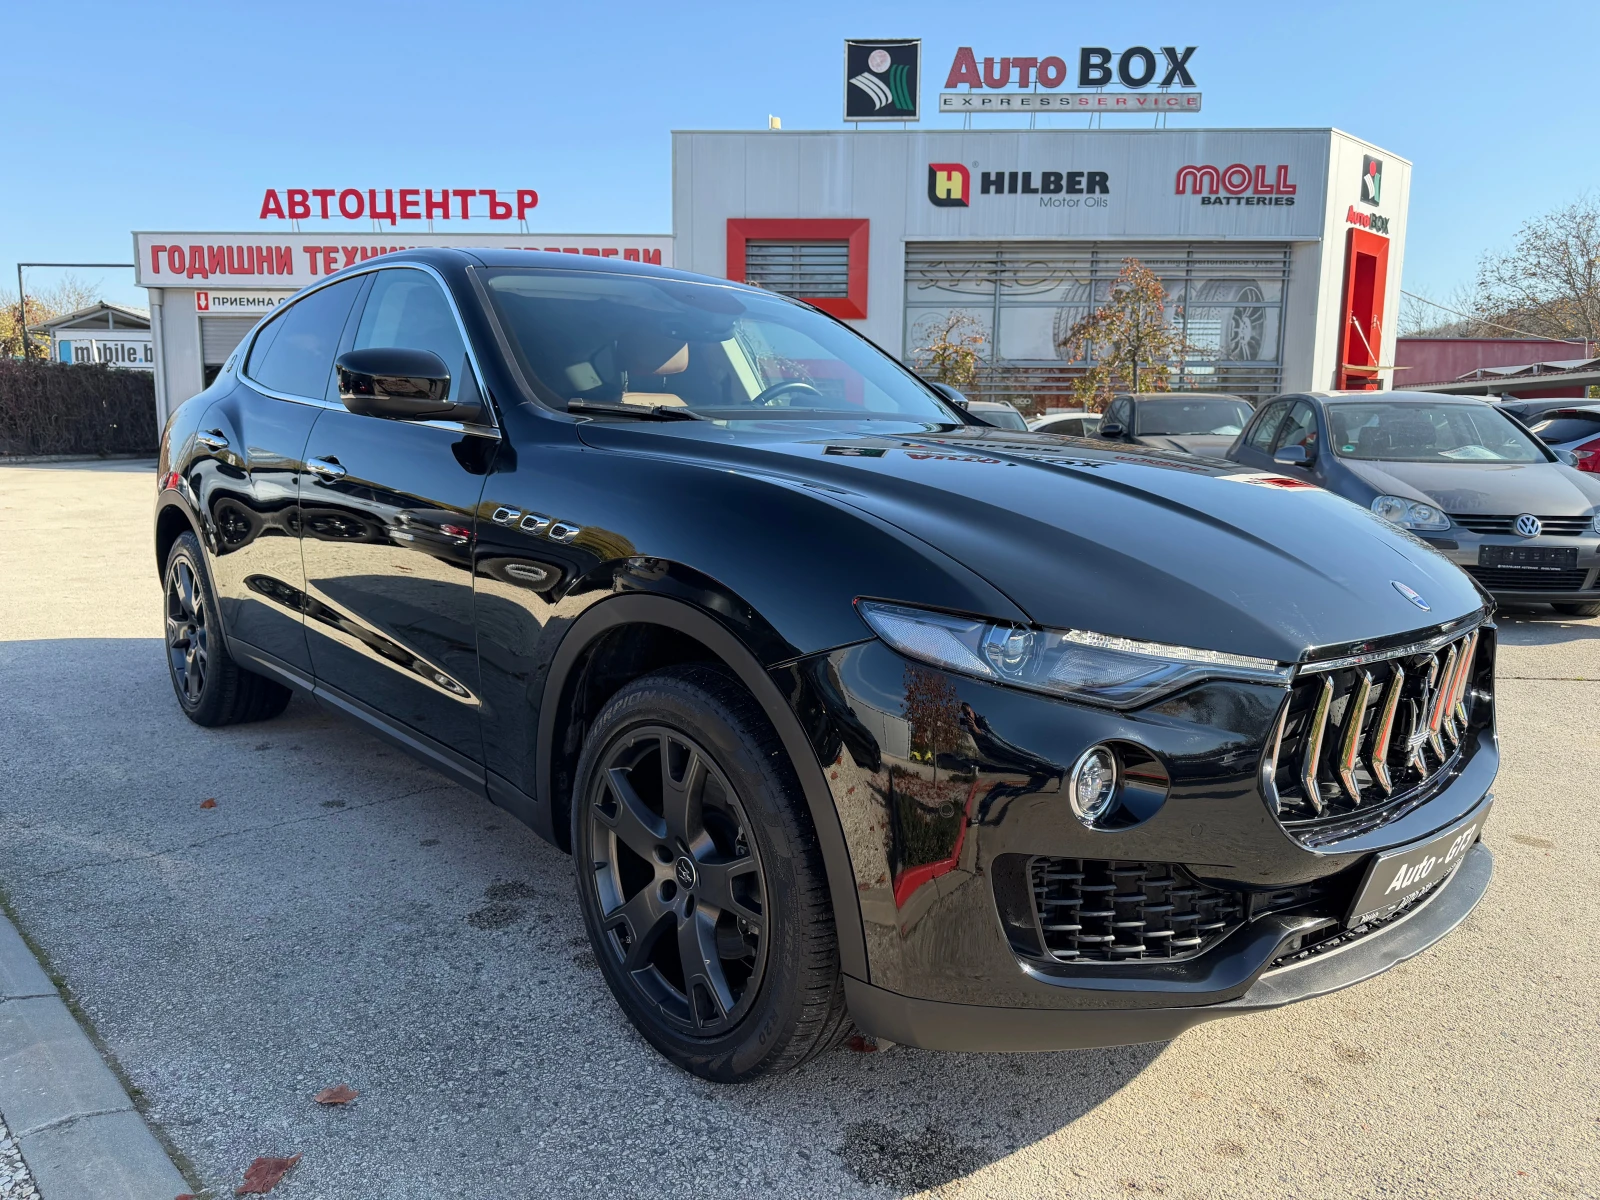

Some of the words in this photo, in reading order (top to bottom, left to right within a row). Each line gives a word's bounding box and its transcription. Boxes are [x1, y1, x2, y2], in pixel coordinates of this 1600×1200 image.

[1077, 46, 1199, 89] BOX
[980, 171, 1110, 195] HILBER
[259, 188, 539, 226] АВТОЦЕНТЪР
[1039, 196, 1080, 208] Motor
[1084, 195, 1109, 208] Oils
[1201, 196, 1295, 206] BATTERIES
[150, 245, 293, 280] ГОДИШНИ
[212, 297, 275, 306] ПРИЕМНА
[1384, 855, 1436, 895] Auto
